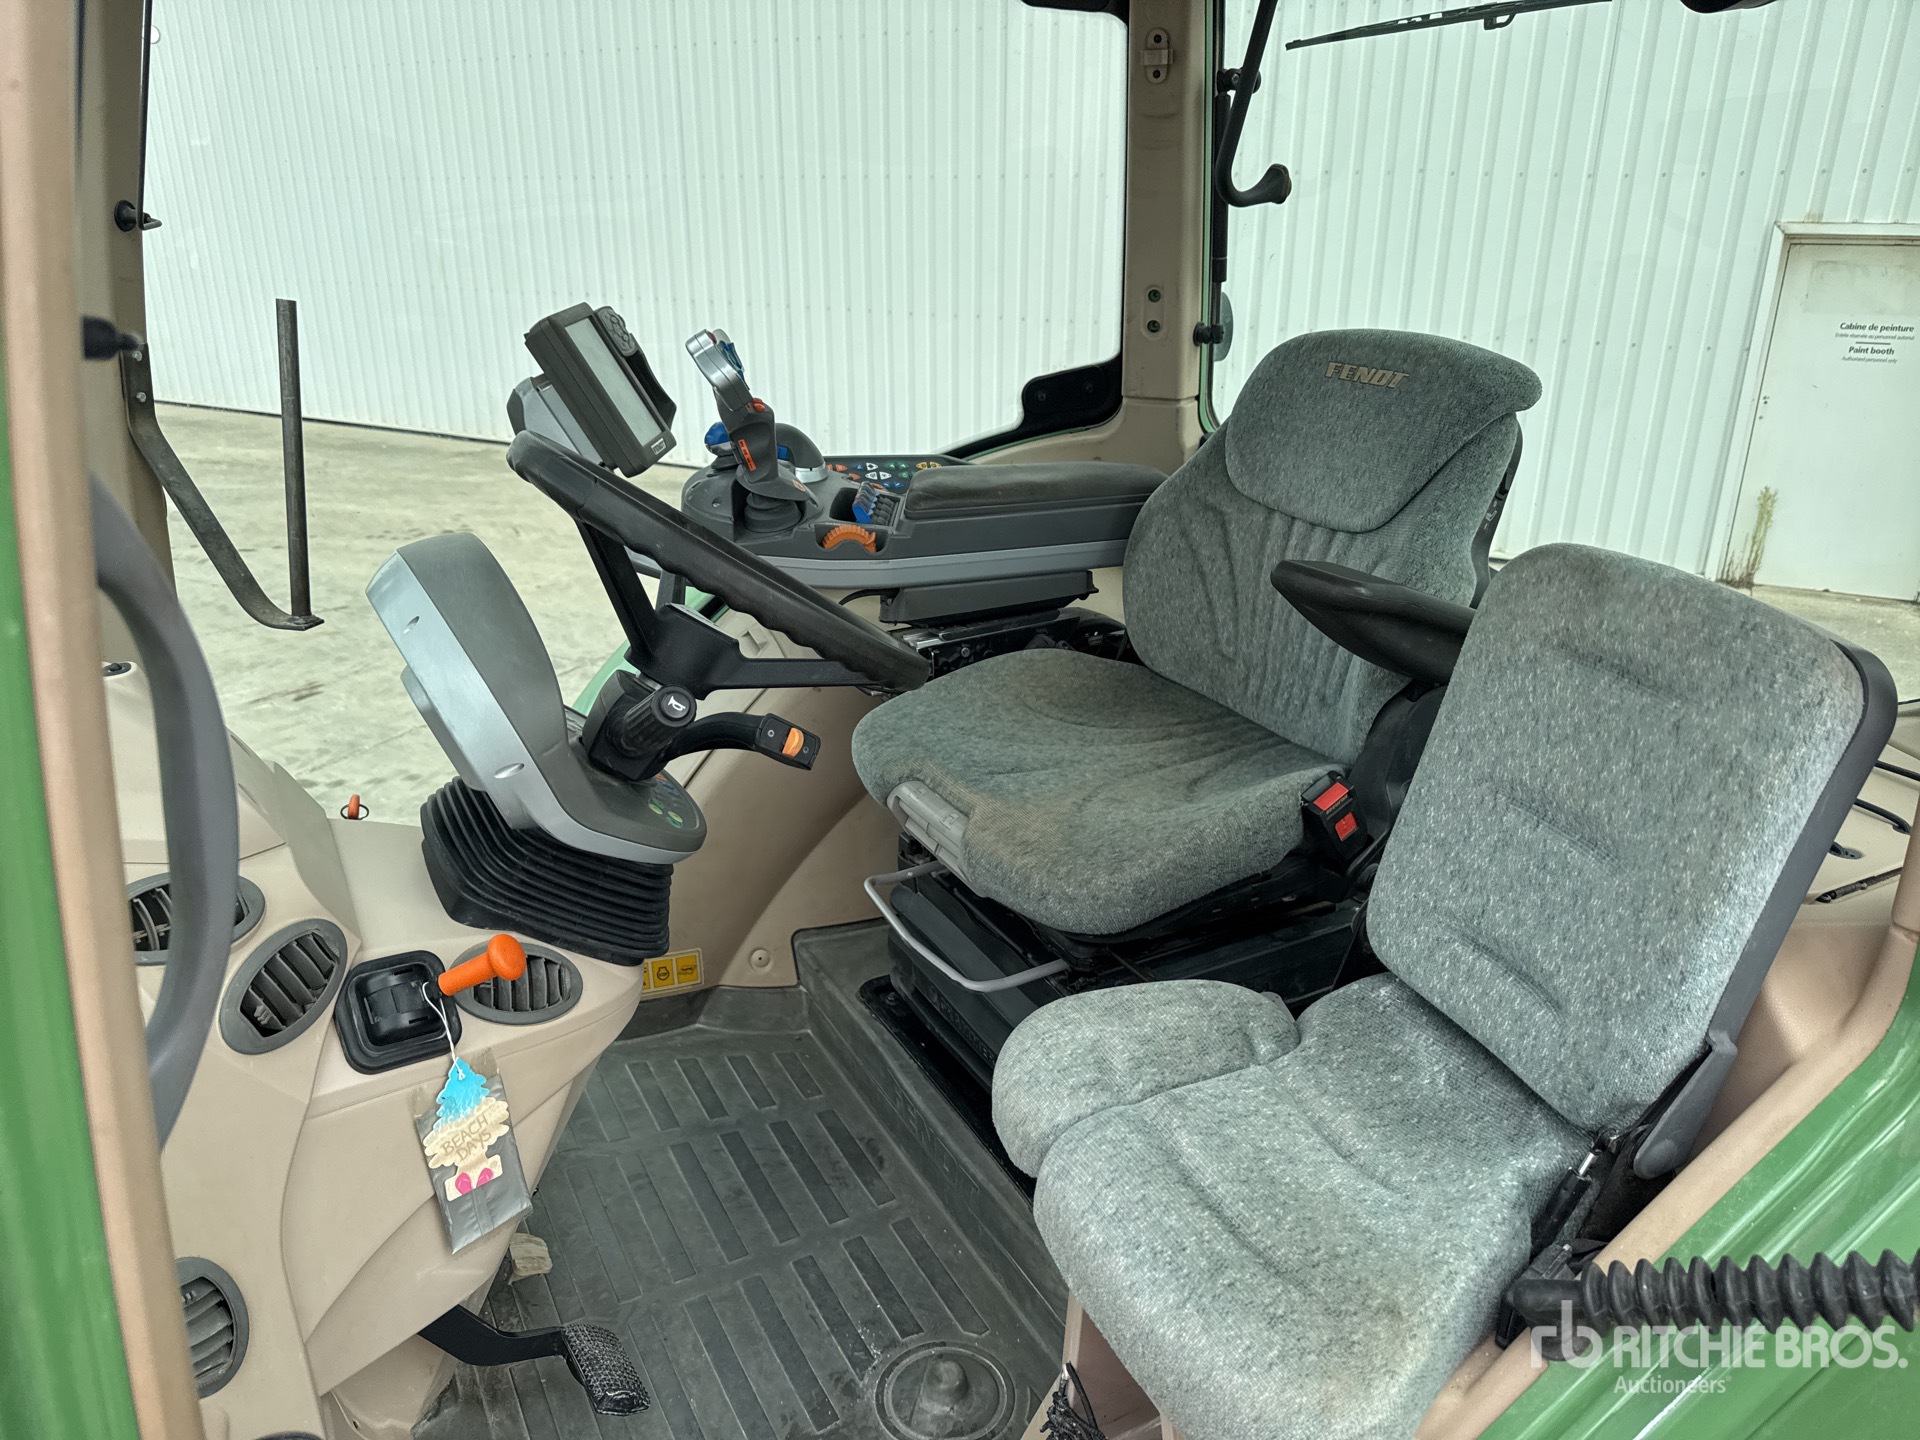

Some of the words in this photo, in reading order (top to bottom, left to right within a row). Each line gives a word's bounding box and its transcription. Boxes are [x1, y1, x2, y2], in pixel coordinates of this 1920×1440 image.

[1839, 322, 1867, 331] Cabine
[1868, 323, 1879, 331] de
[1879, 323, 1915, 333] peinture
[1848, 346, 1869, 354] Paint
[1870, 346, 1895, 355] booth
[1324, 361, 1410, 389] FENDT
[440, 1114, 489, 1157] BEACH
[456, 1128, 492, 1162] DAYS
